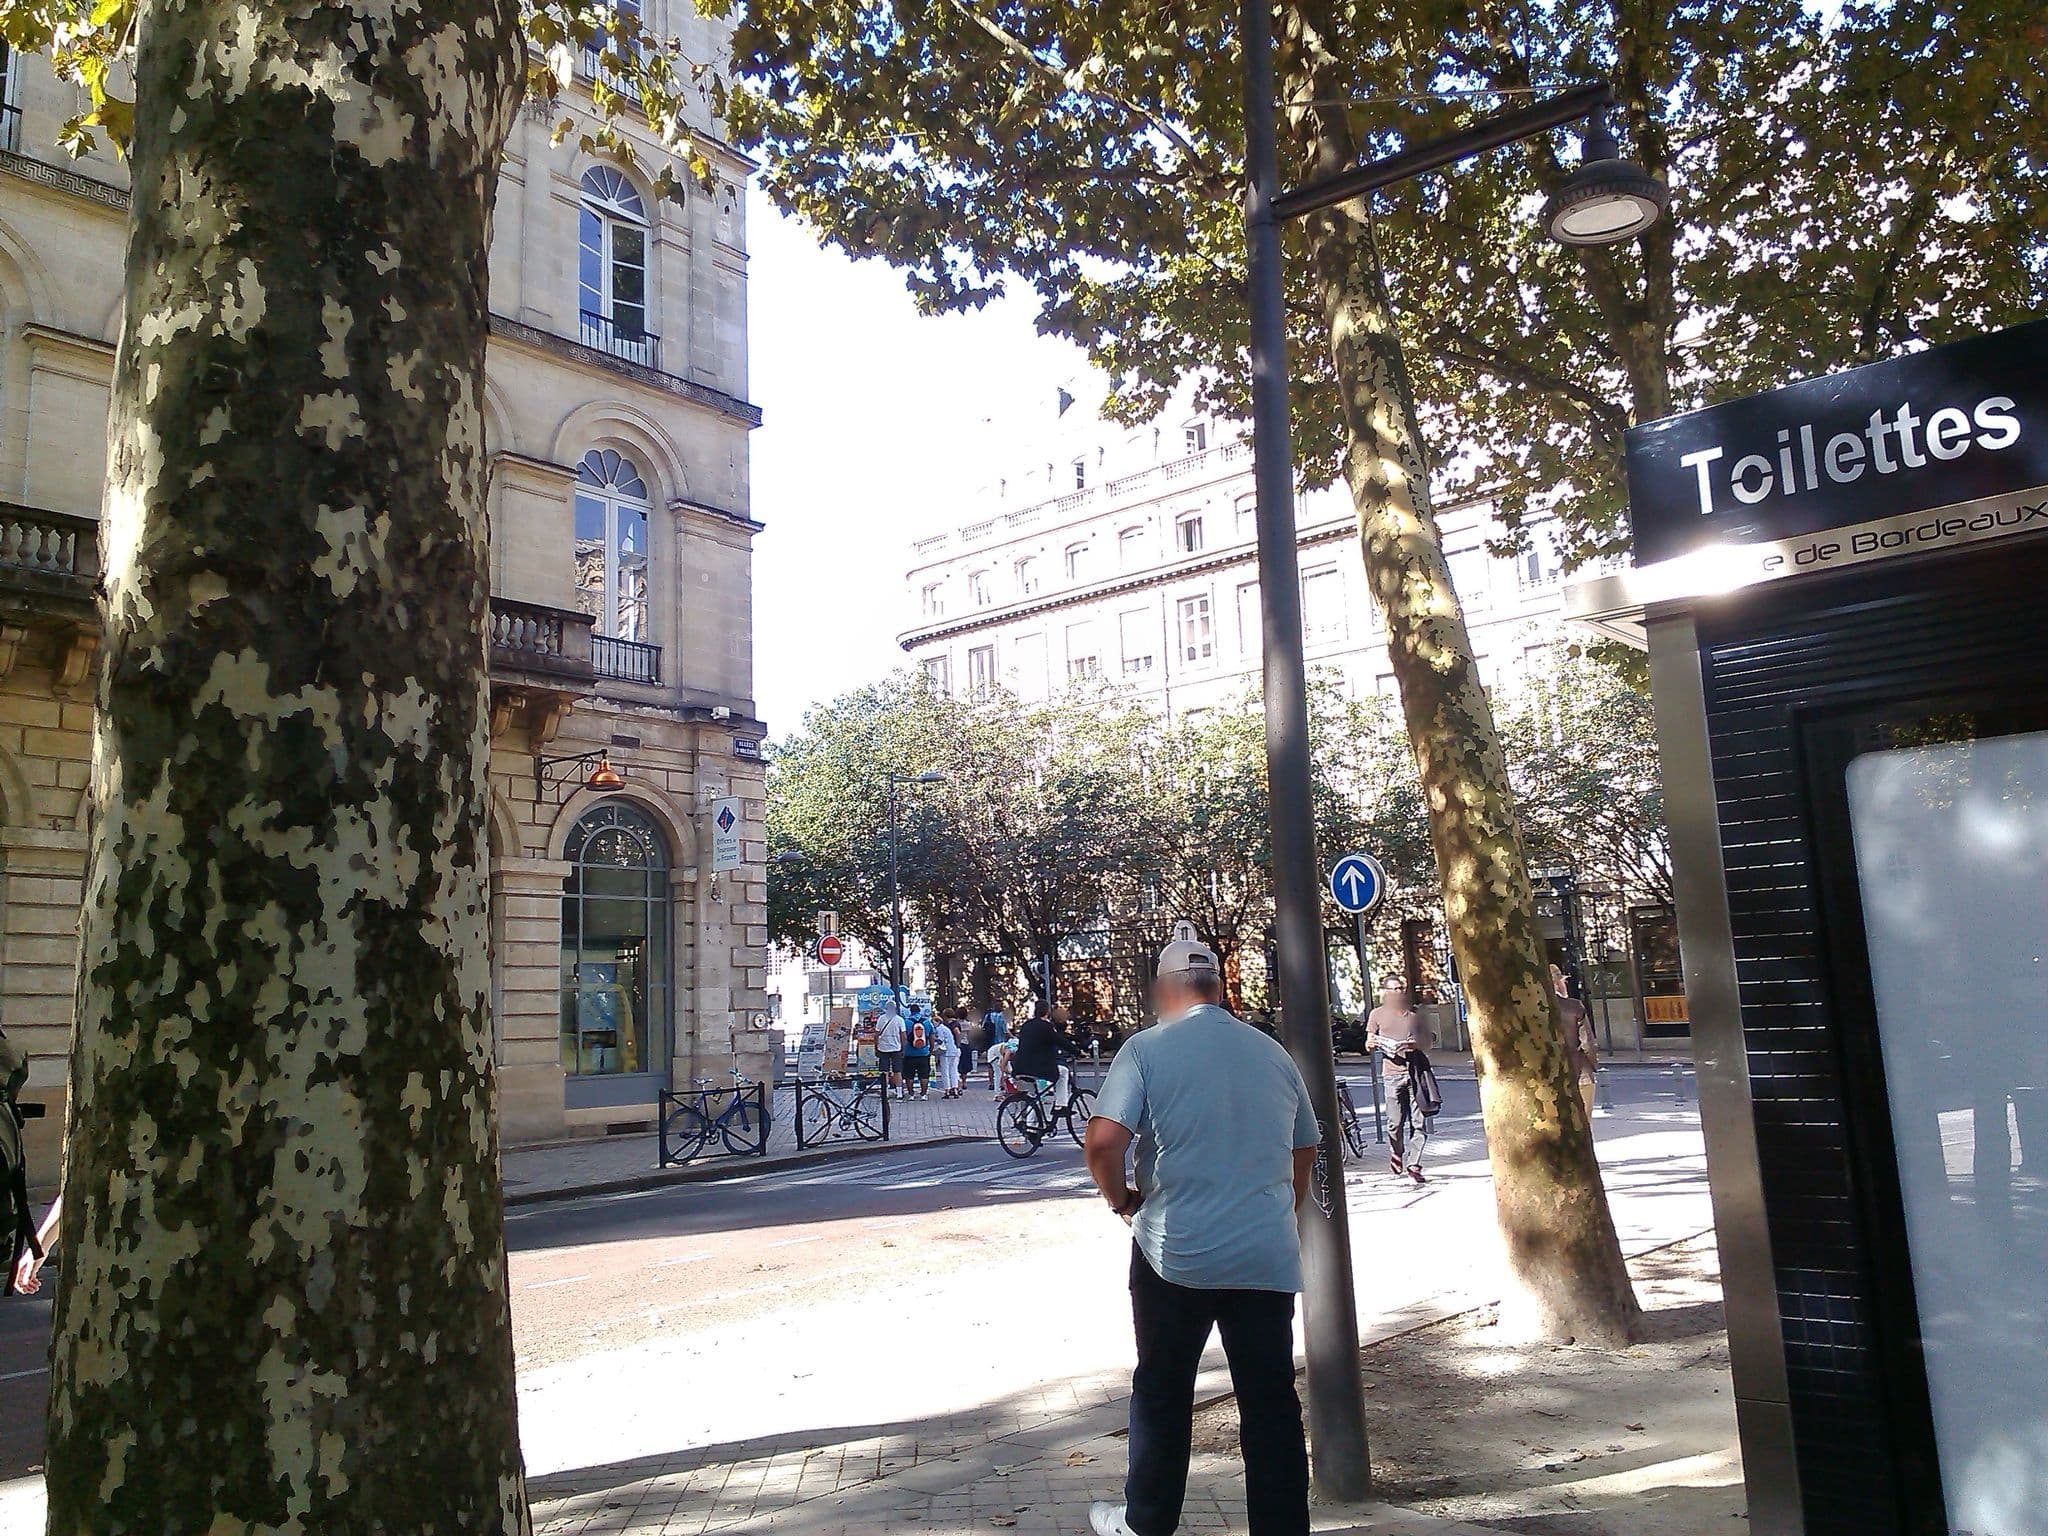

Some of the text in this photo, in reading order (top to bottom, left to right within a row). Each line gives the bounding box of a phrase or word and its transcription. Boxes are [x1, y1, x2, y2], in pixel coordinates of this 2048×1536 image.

[1680, 396, 2022, 515] Toilettes
[1794, 541, 1841, 566] de
[1851, 502, 2048, 555] Bordeaux
